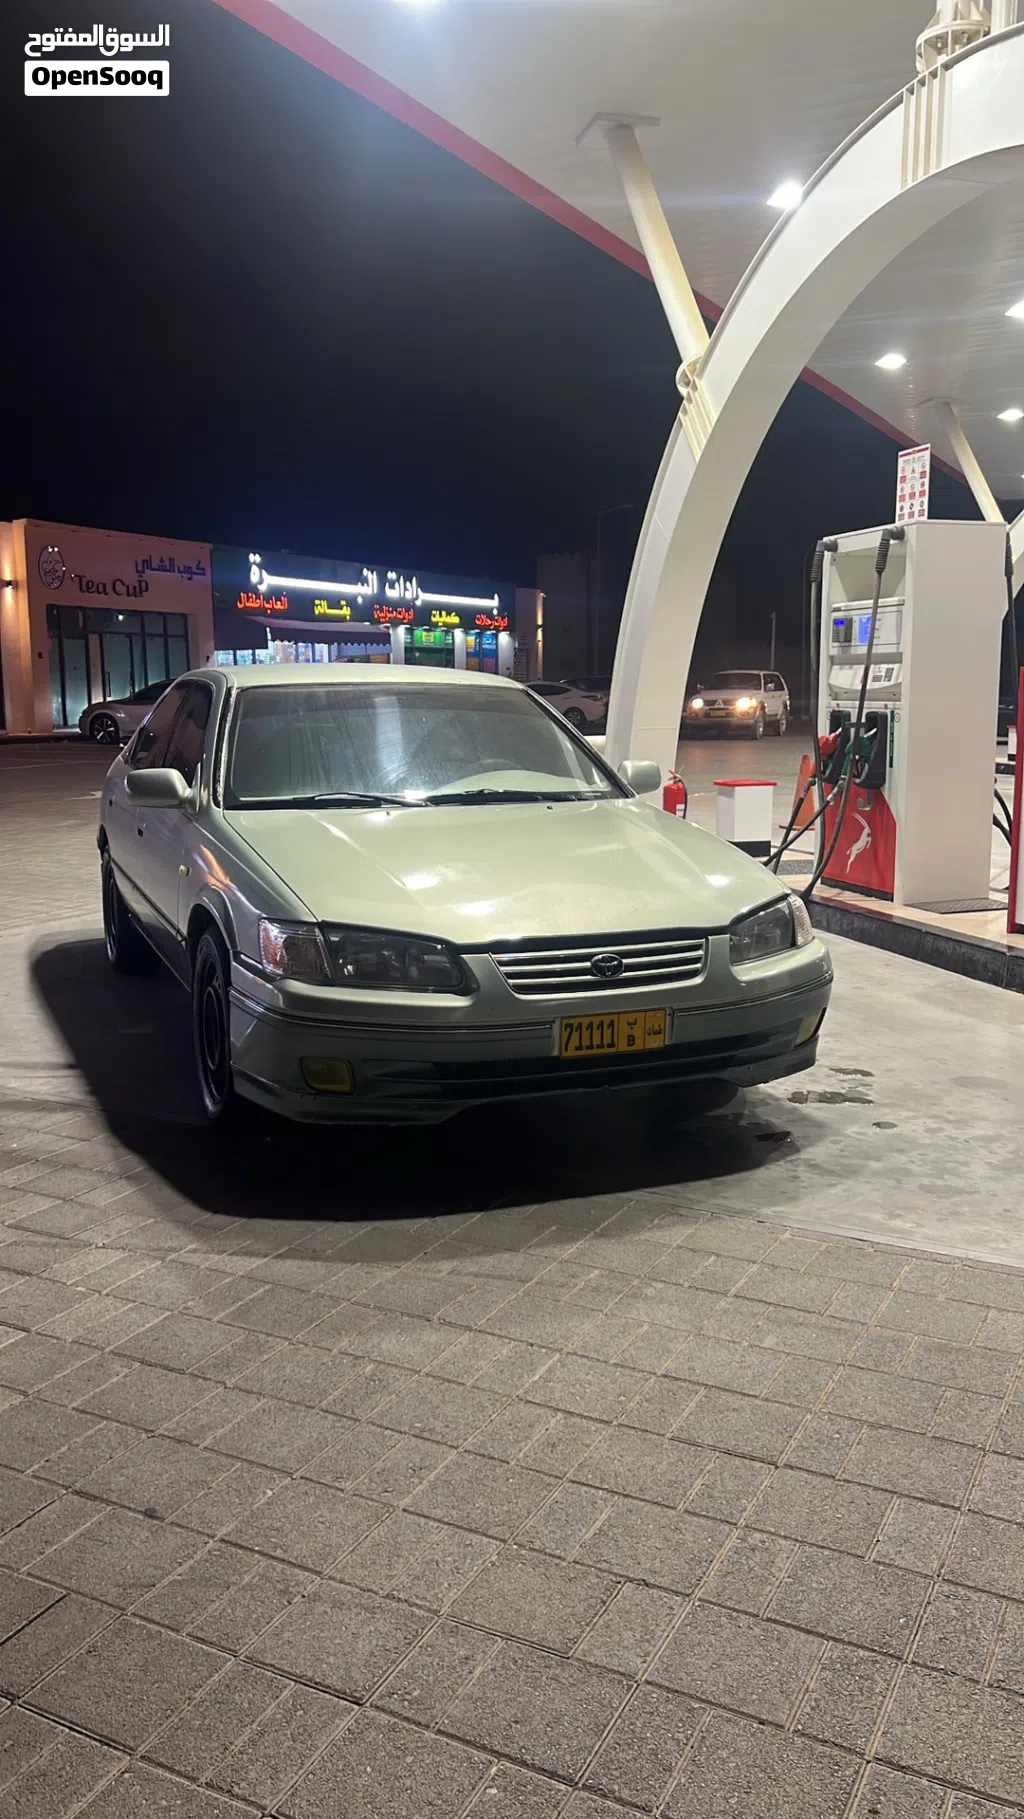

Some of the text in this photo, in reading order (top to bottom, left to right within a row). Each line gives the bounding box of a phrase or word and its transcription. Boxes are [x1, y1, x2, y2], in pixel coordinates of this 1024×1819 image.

[134, 554, 206, 581] كوب الشاي
[71, 574, 109, 596] Tea
[313, 598, 352, 621] بقالة
[430, 609, 461, 627] كماليات
[626, 1017, 638, 1031] ب
[564, 1018, 616, 1053] 71111
[626, 1034, 636, 1047] B
